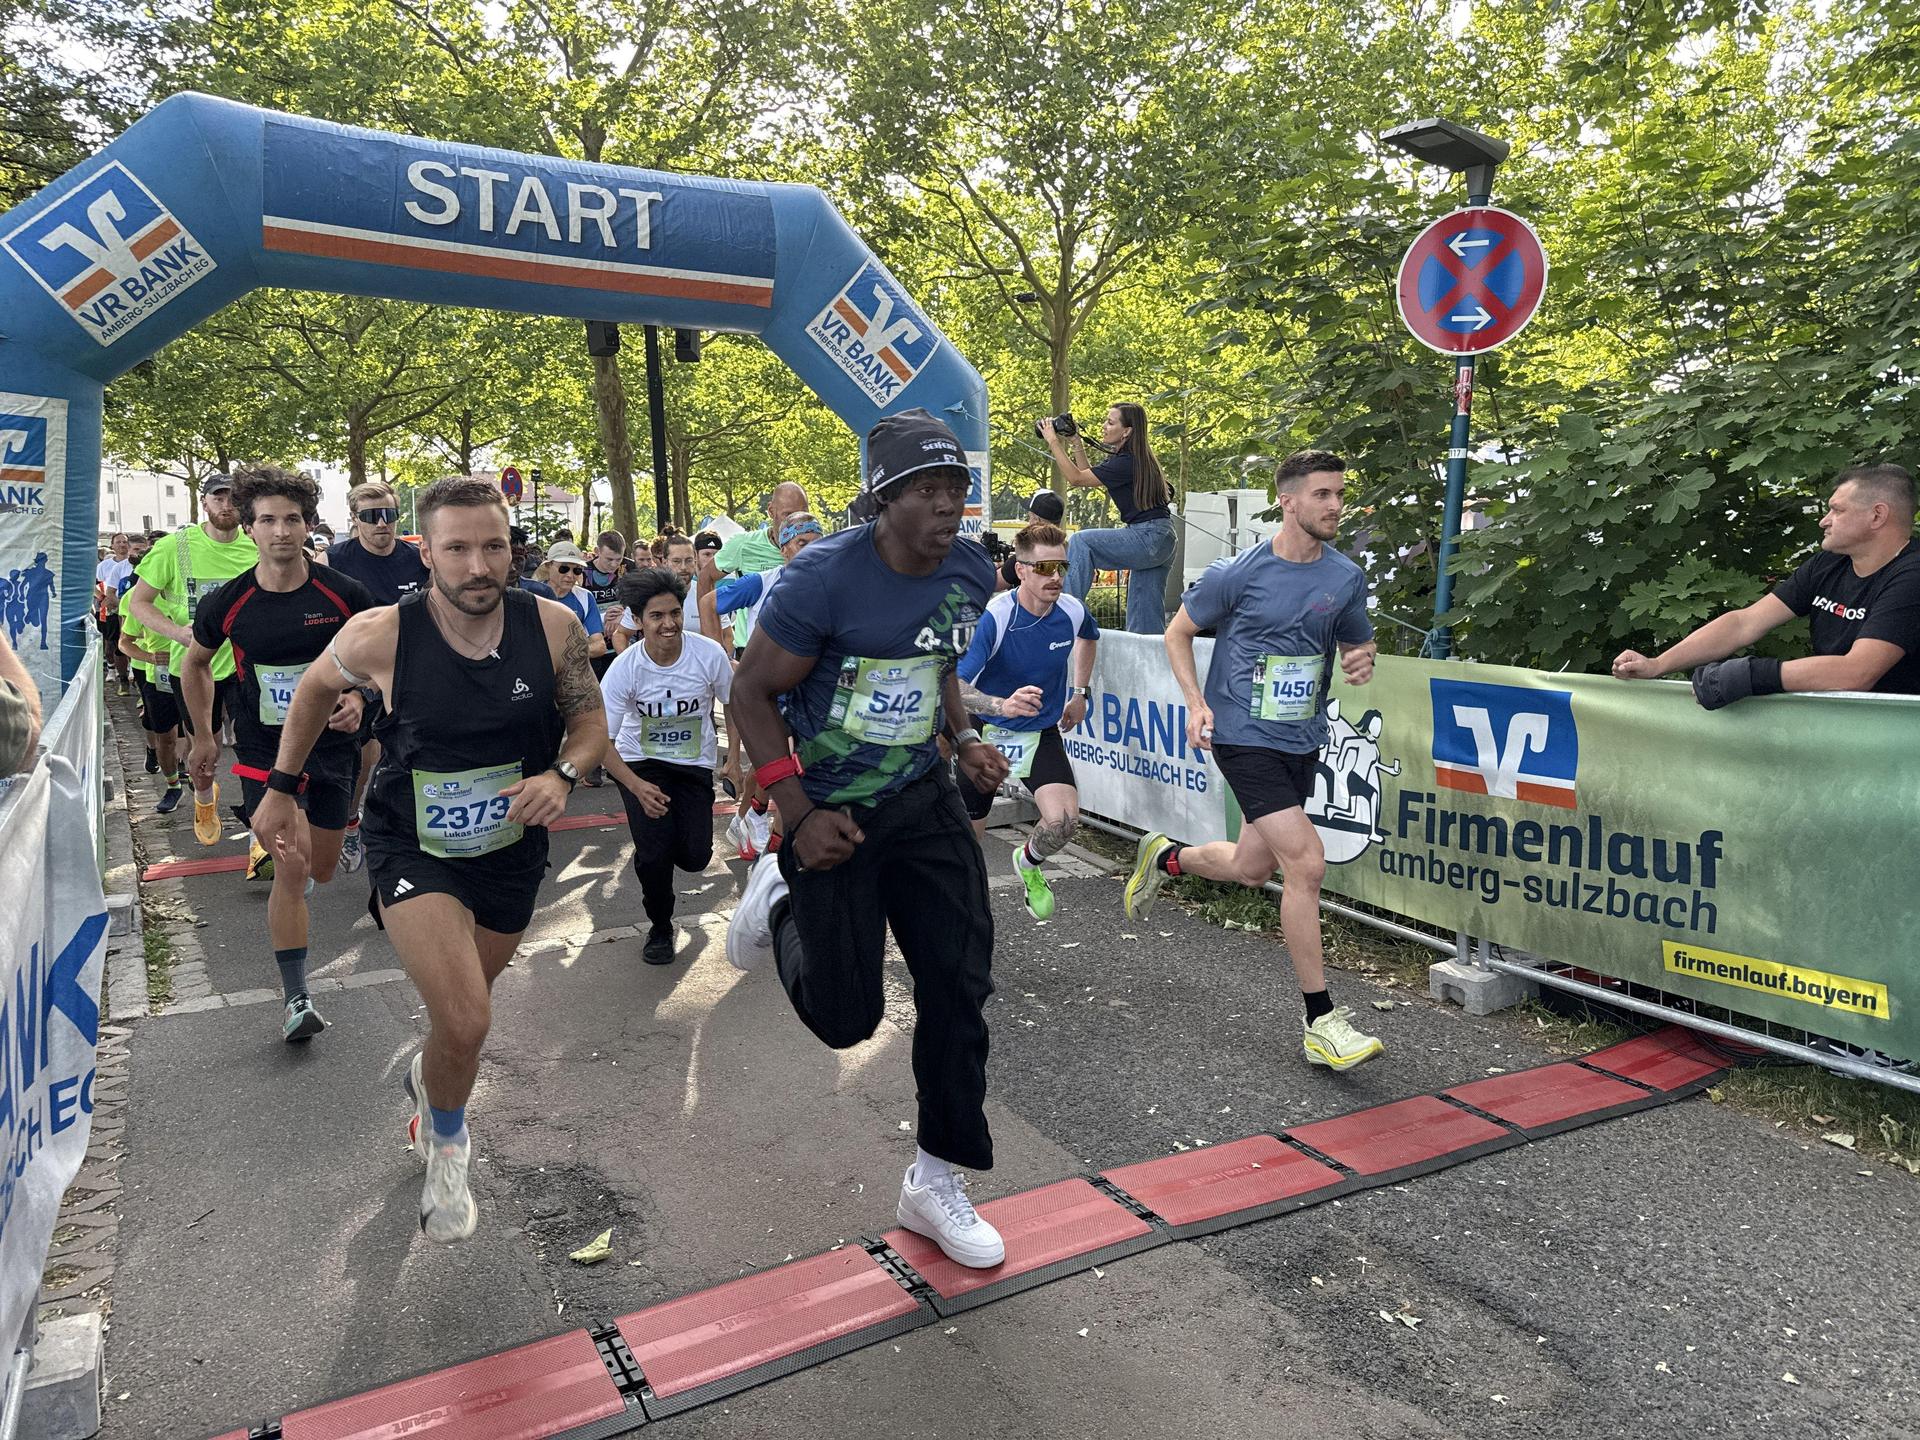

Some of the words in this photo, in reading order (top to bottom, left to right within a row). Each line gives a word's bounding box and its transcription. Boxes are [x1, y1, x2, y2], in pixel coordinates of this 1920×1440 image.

[404, 160, 663, 250] START
[79, 292, 129, 328] VR
[120, 237, 201, 303] BANK
[101, 268, 196, 340] AMBERG-SULZBACH
[193, 258, 209, 273] EG
[811, 326, 876, 393] AMBERG-SULZBACH
[874, 391, 886, 403] EG
[822, 310, 850, 346] VR
[845, 339, 901, 398] BANK
[0, 486, 44, 506] ANK
[959, 519, 982, 533] ANK
[270, 688, 295, 704] 14
[869, 690, 923, 715] 542
[1273, 681, 1315, 697] 1450
[648, 730, 692, 743] 2196
[1064, 738, 1181, 787] MBERG-SULZBACH
[1186, 768, 1207, 793] EG
[426, 796, 511, 829] 2373
[444, 830, 472, 838] Lukas
[473, 822, 501, 834] Graml
[1398, 789, 1724, 889] Firmenlauf
[1379, 847, 1718, 934] amberg-sulzbach
[1673, 950, 1878, 1011] firmenlauf.bayern
[0, 912, 109, 1136] ANK
